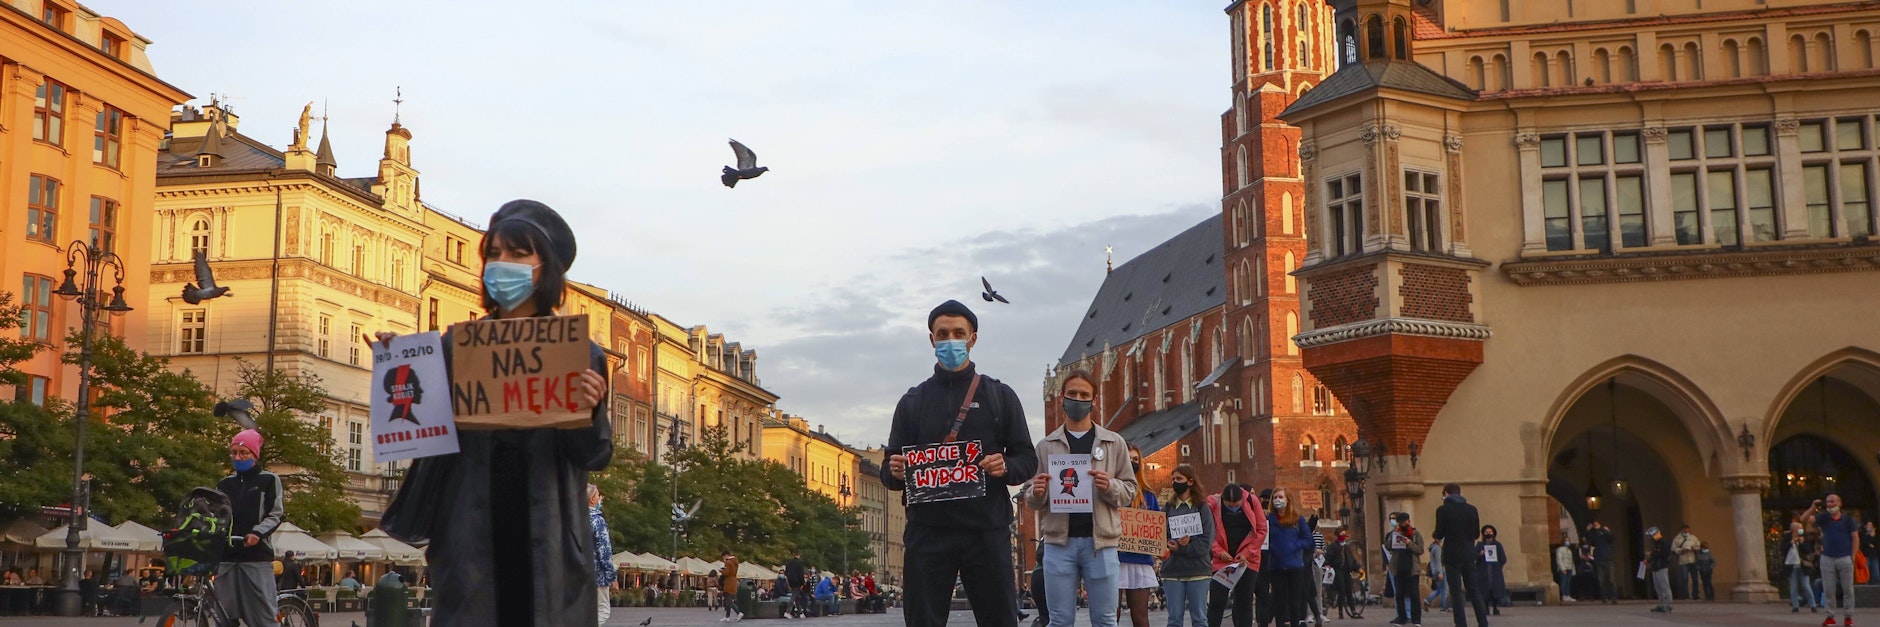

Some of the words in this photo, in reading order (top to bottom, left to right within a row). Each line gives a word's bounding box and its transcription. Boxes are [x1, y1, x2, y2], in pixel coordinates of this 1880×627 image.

[458, 317, 580, 347] SKAZUJECIE
[401, 345, 434, 359] 22/10
[492, 346, 543, 378] NAS
[390, 382, 415, 393] STRAJK
[392, 390, 415, 400] KOBIET
[454, 380, 491, 416] NA
[502, 371, 581, 415] MĘKĘ
[377, 430, 413, 445] OSTRA
[415, 425, 449, 439] JAZDA
[913, 460, 979, 488] WYBÓR
[1135, 511, 1165, 526] CIAŁO
[1138, 544, 1162, 554] KOBIETY
